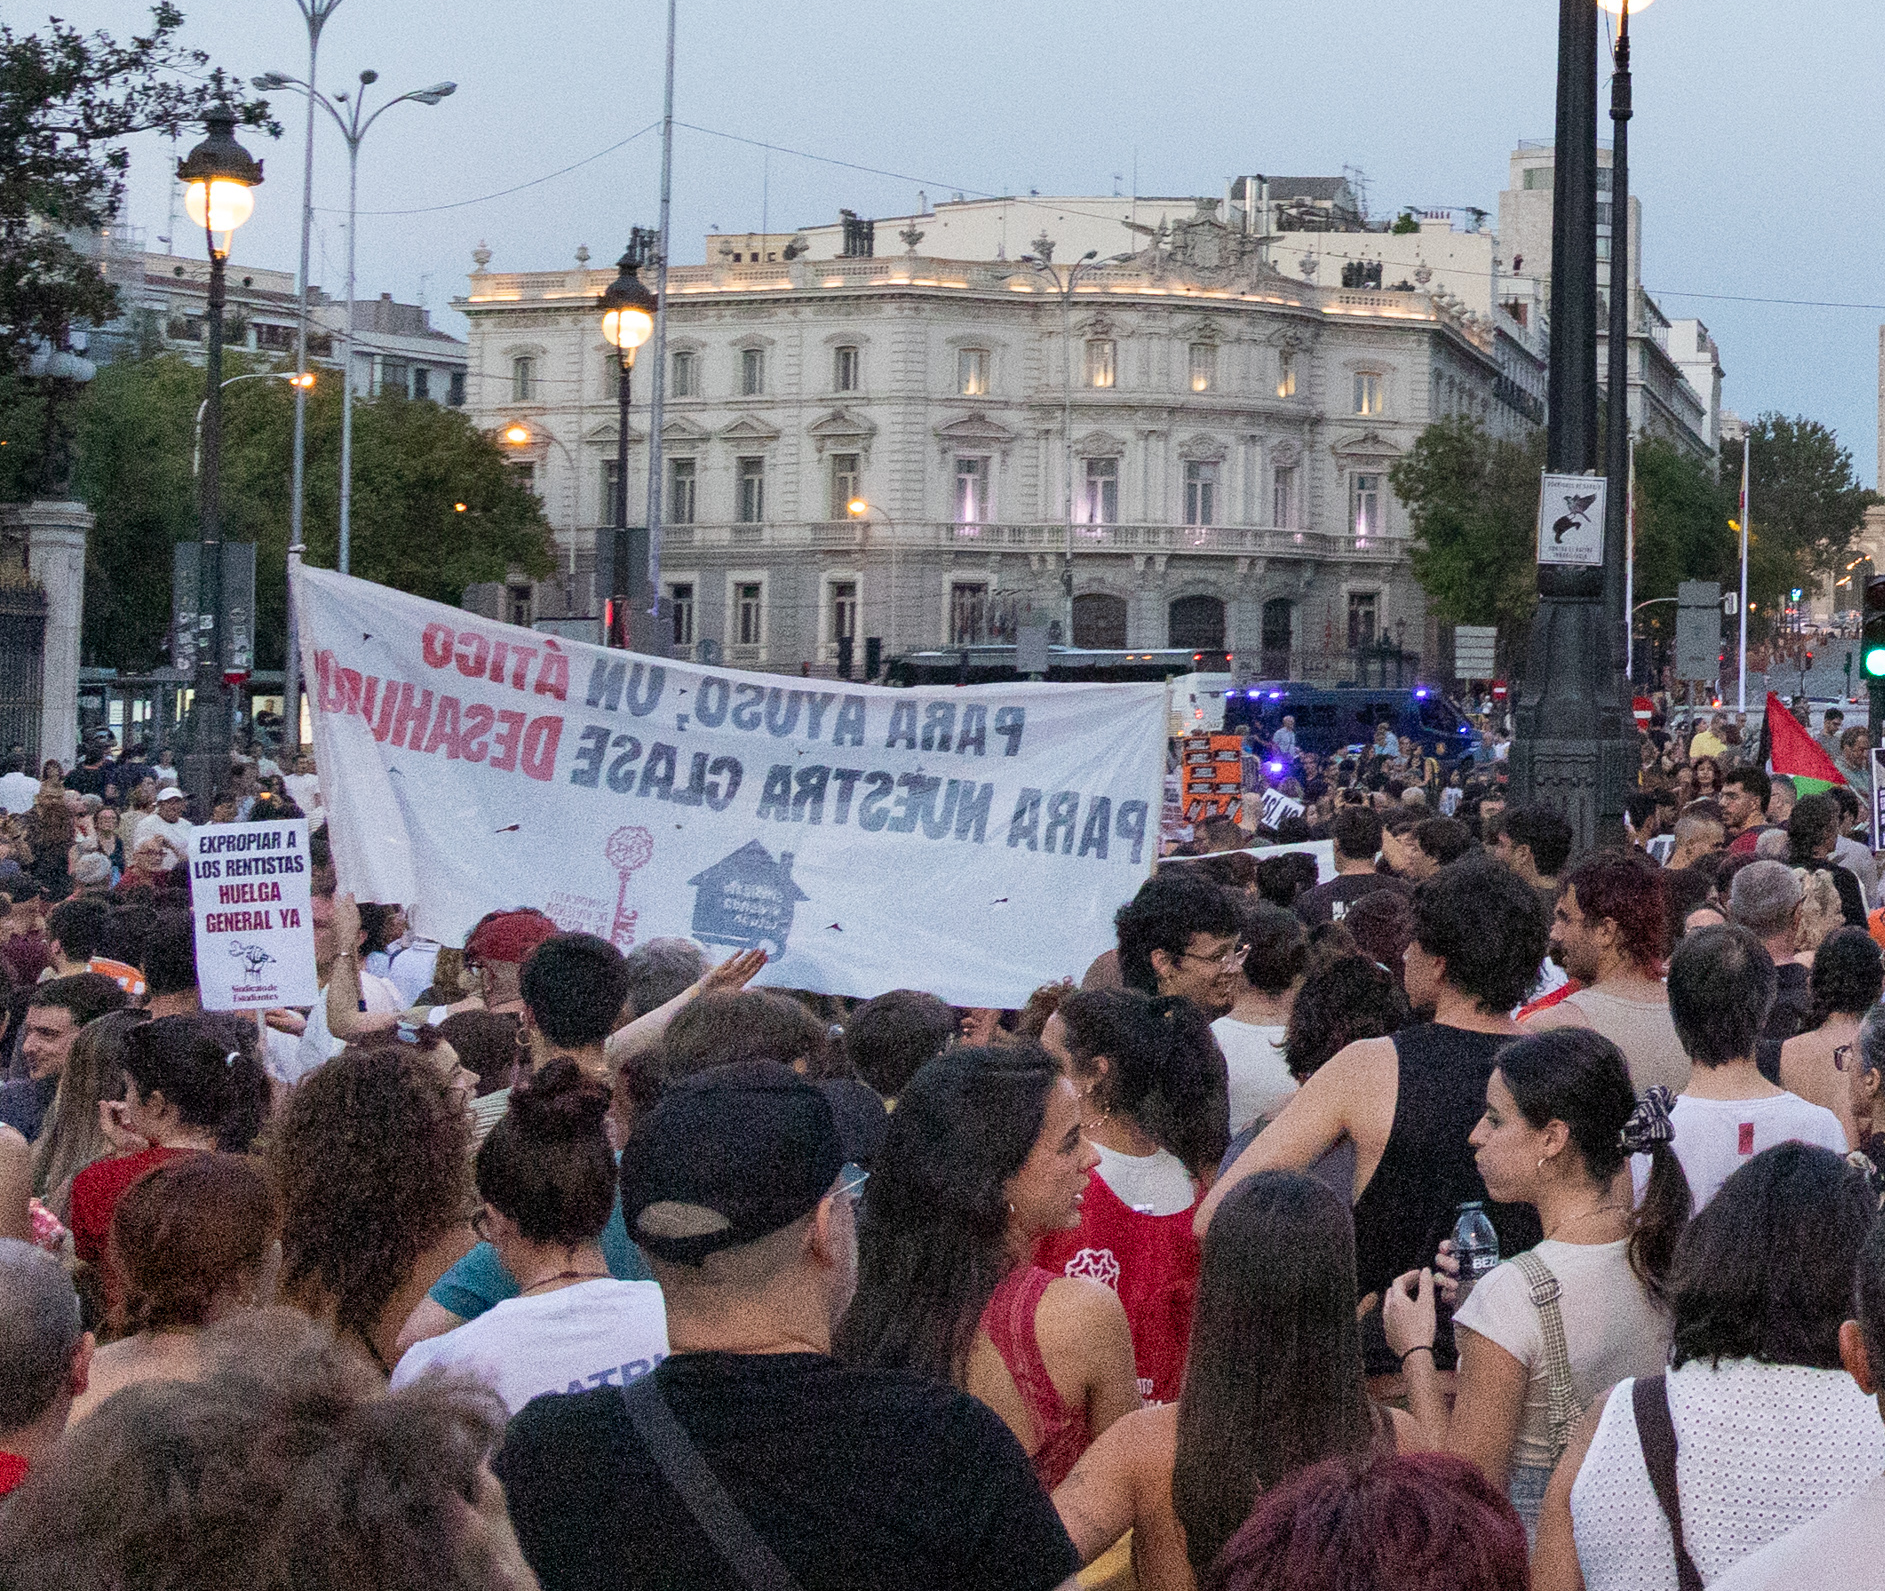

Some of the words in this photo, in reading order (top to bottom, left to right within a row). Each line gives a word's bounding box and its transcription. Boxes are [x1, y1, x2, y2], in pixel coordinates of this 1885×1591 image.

[199, 831, 282, 854] EXPROPIAR
[286, 830, 297, 849] A
[194, 860, 221, 879] LOS
[225, 855, 305, 878] RENTISTAS
[218, 881, 282, 905] HUELGA
[206, 910, 273, 934] GENERAL
[279, 908, 301, 929] YA
